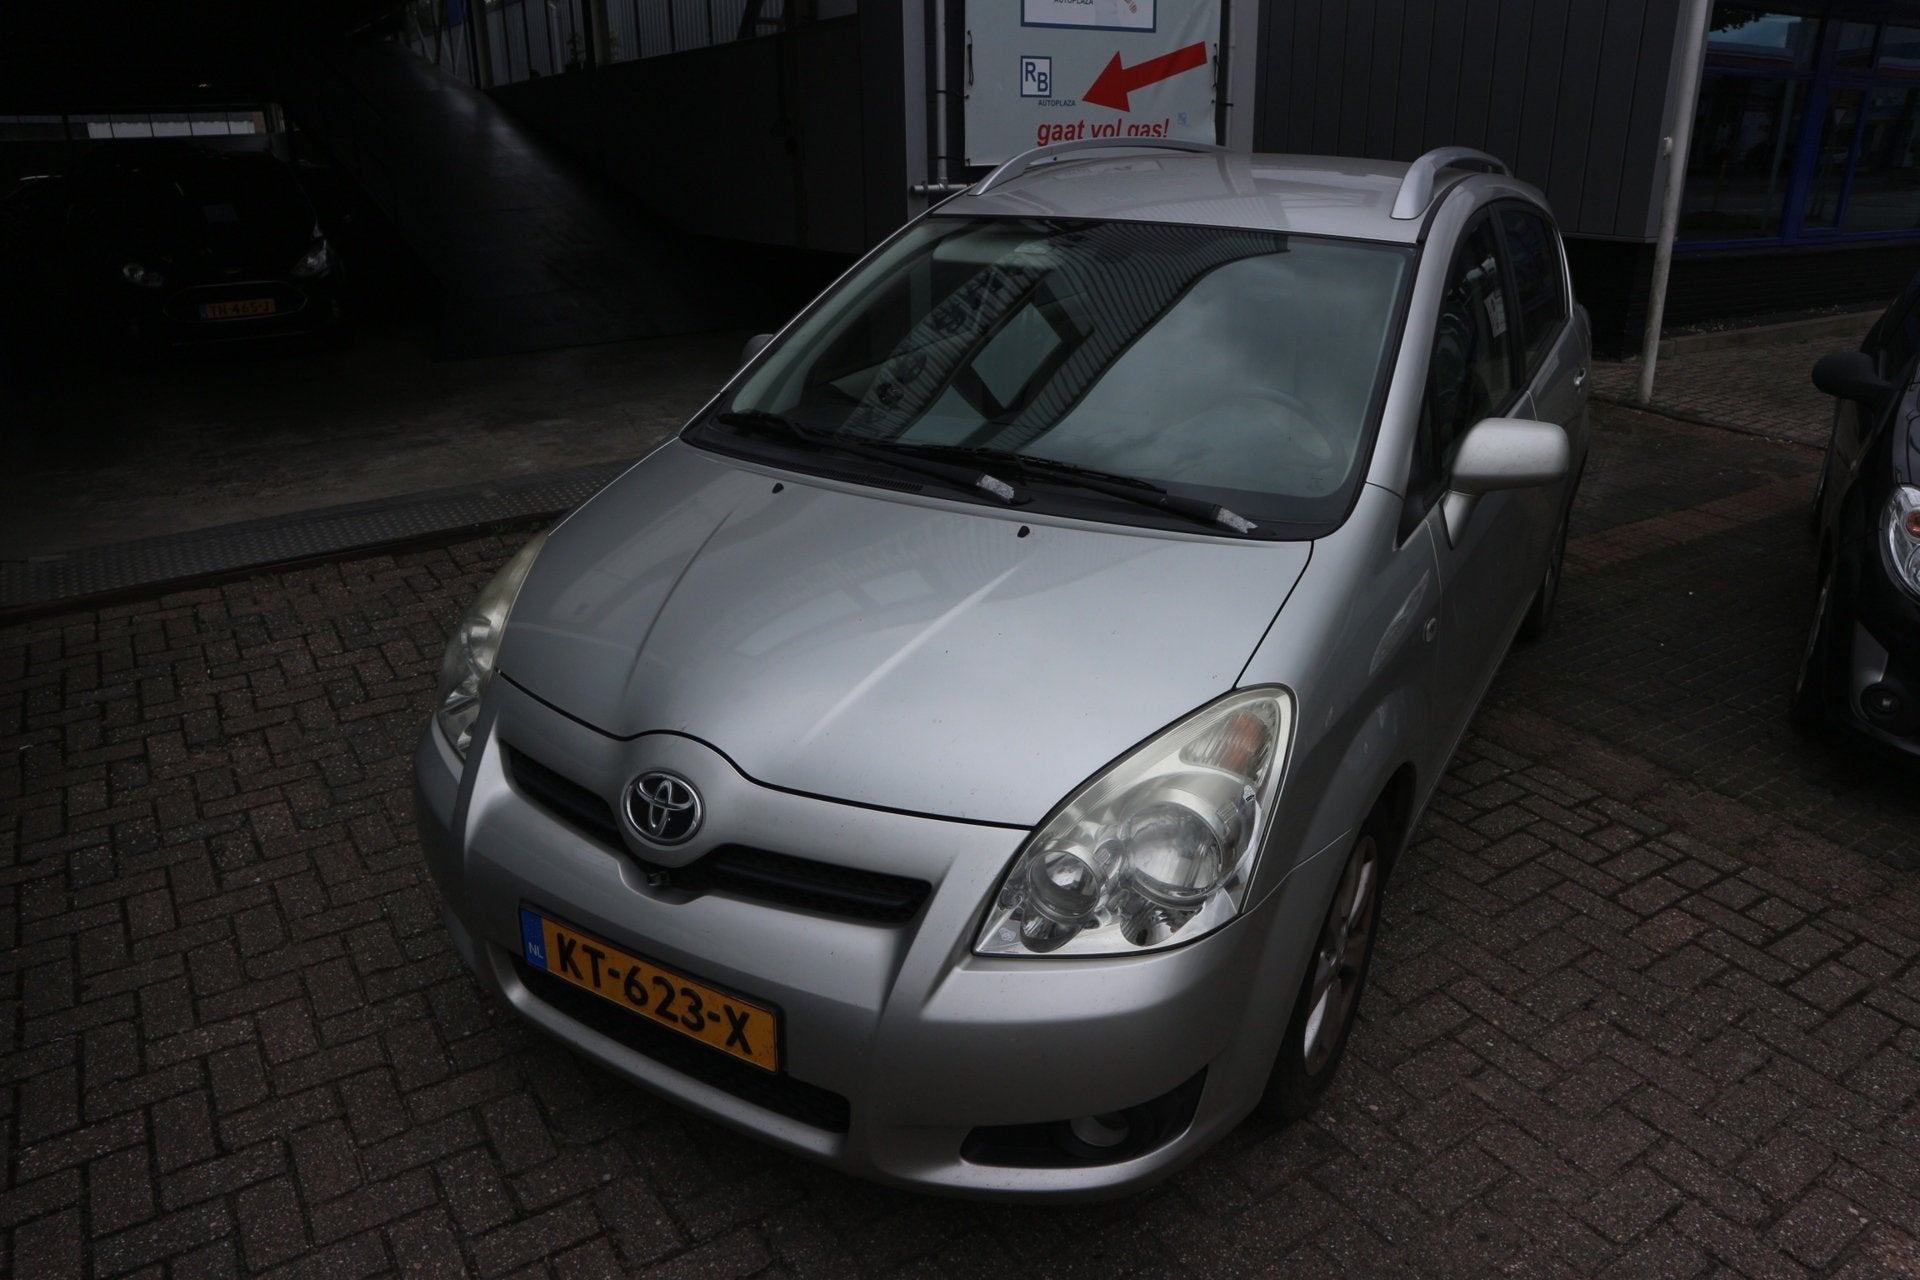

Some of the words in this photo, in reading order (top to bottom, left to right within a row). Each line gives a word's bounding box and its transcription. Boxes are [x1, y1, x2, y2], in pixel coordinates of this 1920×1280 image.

[1037, 120, 1085, 146] gaat
[1092, 118, 1122, 137] vol
[528, 942, 544, 960] NL
[556, 932, 753, 1055] KT-623-X
